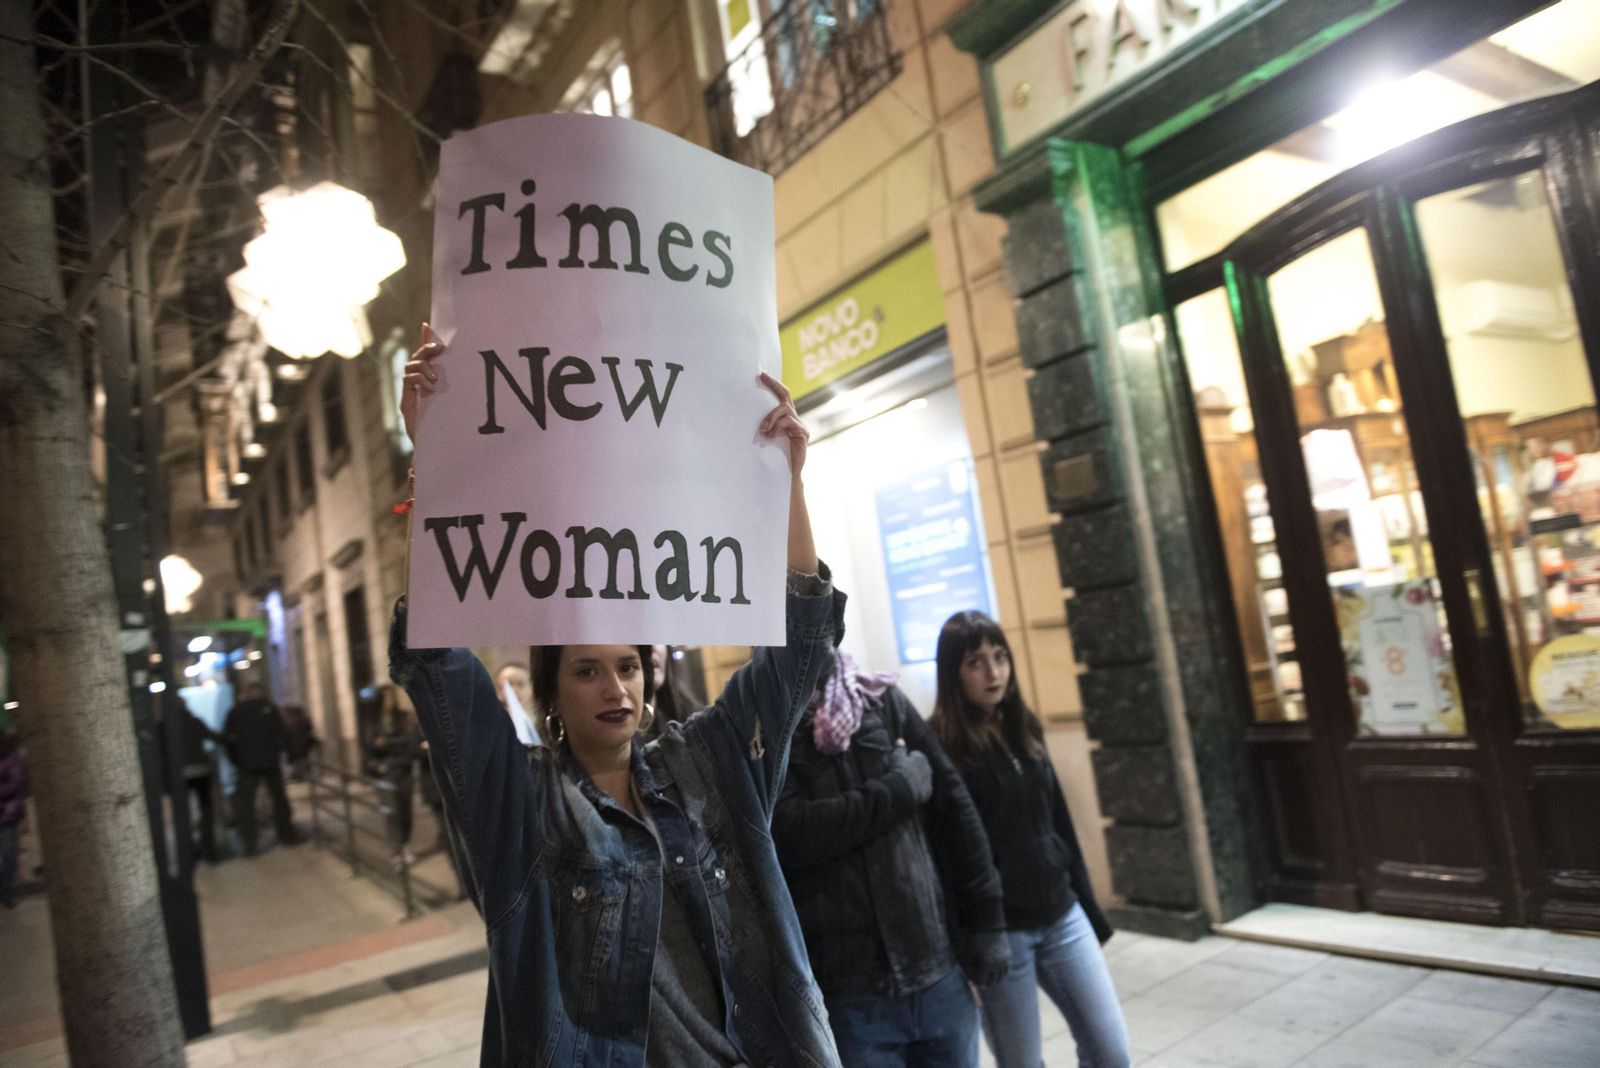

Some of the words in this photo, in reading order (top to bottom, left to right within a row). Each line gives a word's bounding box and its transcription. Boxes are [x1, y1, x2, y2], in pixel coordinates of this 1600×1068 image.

[458, 179, 735, 288] Times
[798, 296, 860, 353] NOVO
[802, 320, 879, 381] BANCO
[477, 346, 684, 435] New
[423, 512, 752, 605] Woman
